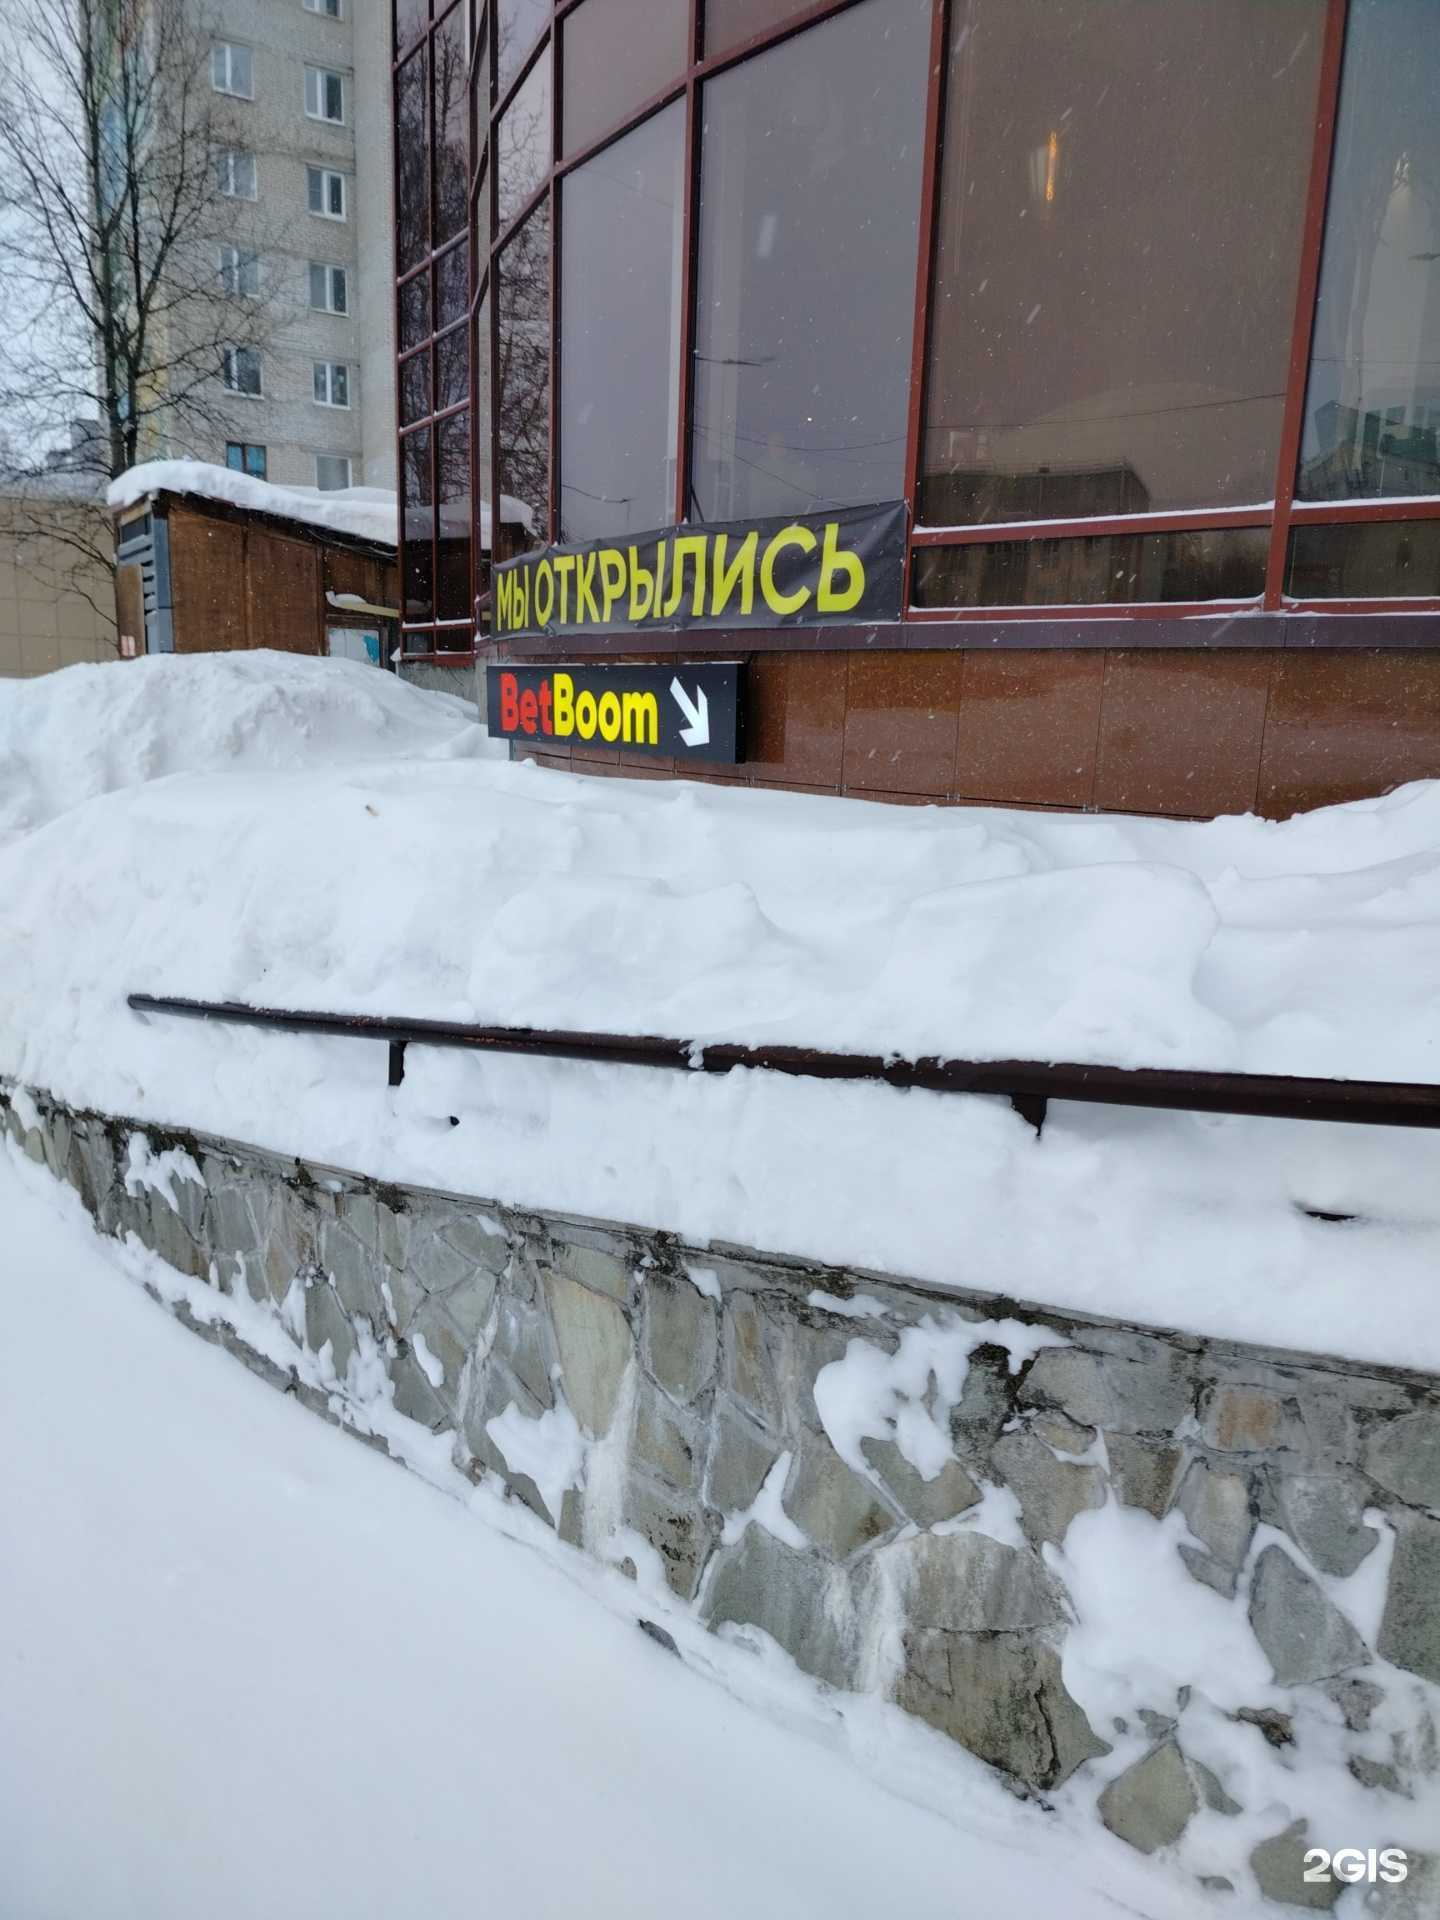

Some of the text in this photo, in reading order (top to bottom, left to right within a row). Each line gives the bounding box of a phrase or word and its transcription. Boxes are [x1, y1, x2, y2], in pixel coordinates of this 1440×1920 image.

[497, 523, 866, 632] МЫ ОТКРЫЛИСЬ
[500, 672, 658, 745] BetBoom
